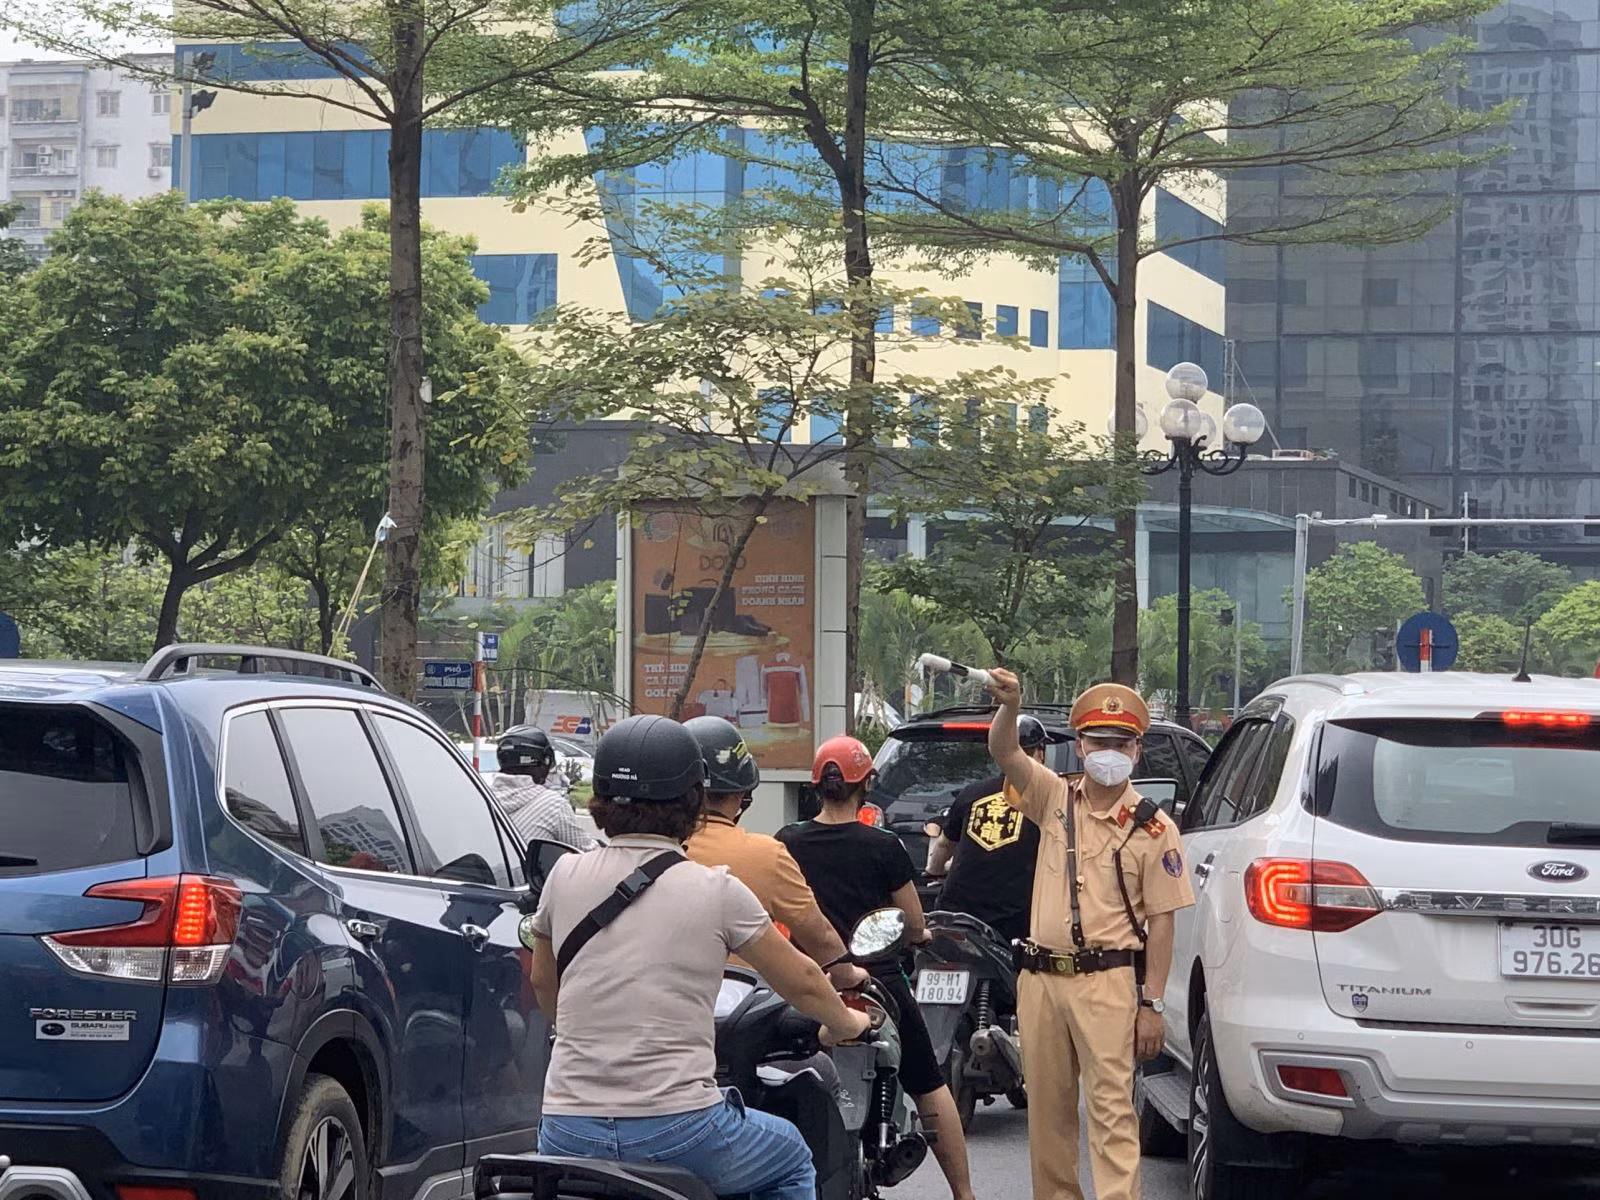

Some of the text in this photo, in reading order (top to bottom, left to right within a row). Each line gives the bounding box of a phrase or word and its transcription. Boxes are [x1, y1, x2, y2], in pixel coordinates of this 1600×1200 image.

[699, 555, 747, 570] DOO
[1541, 862, 1576, 877] Ford
[1410, 893, 1600, 913] EVER
[1532, 925, 1581, 949] 30G
[1513, 951, 1600, 976] 976.26
[920, 987, 963, 1001] 180.94
[1336, 984, 1432, 996] TITANIUM
[30, 1007, 138, 1020] FORESTER
